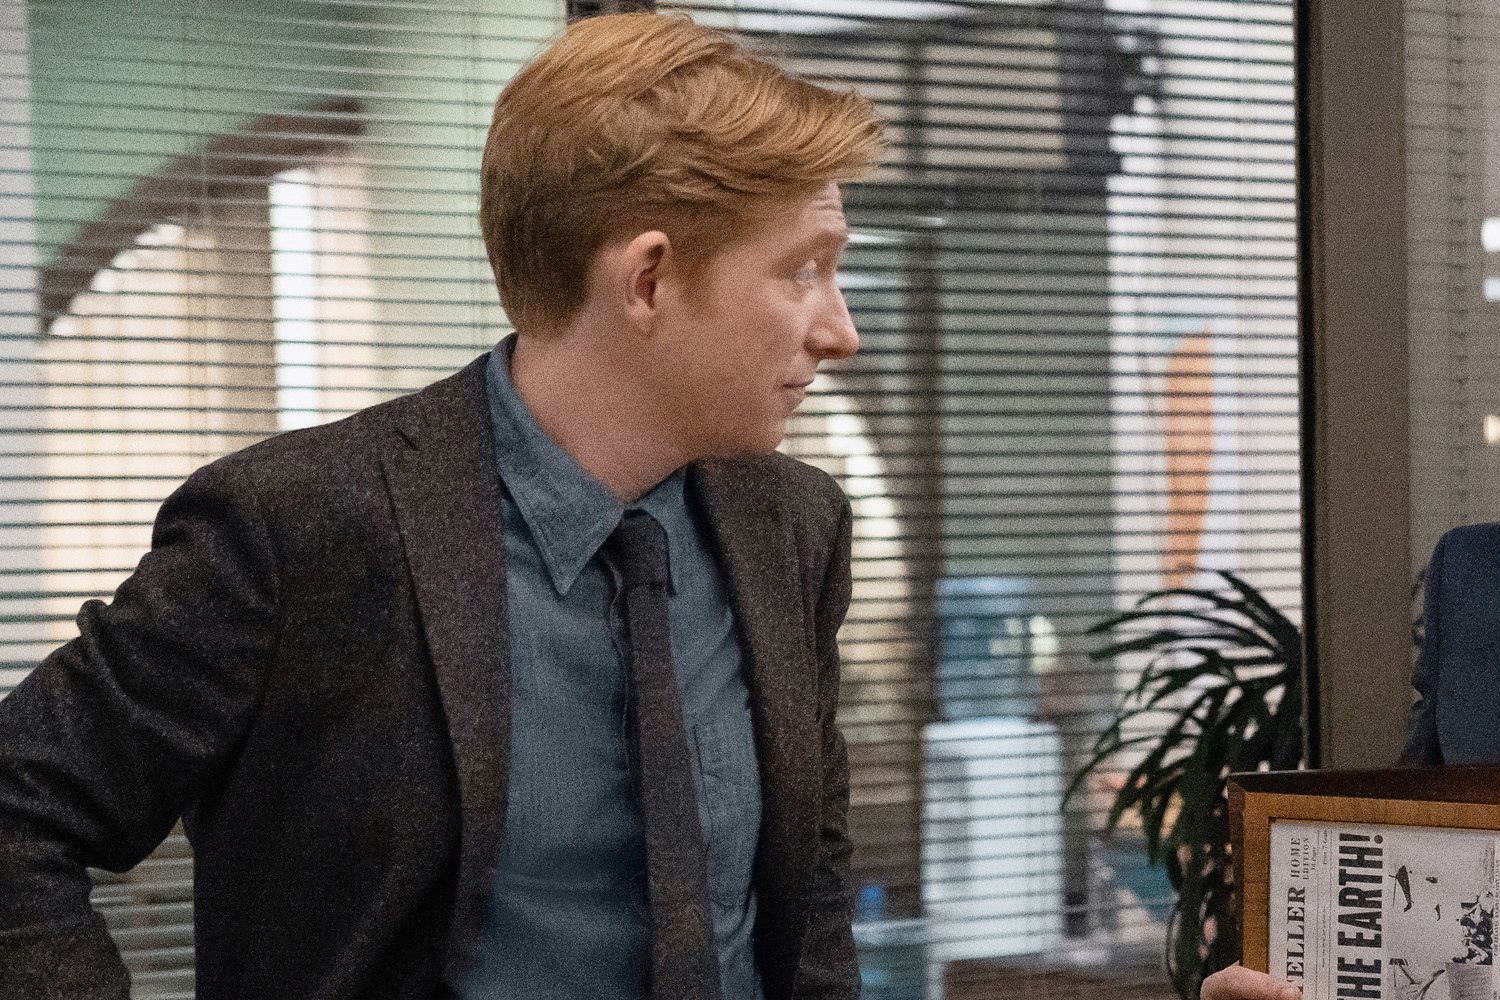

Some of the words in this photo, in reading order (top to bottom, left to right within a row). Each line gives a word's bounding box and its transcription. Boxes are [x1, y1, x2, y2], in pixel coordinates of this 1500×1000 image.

[1290, 838, 1301, 878] HOME
[1302, 837, 1310, 880] EDITION
[1338, 833, 1384, 948] EARTH!
